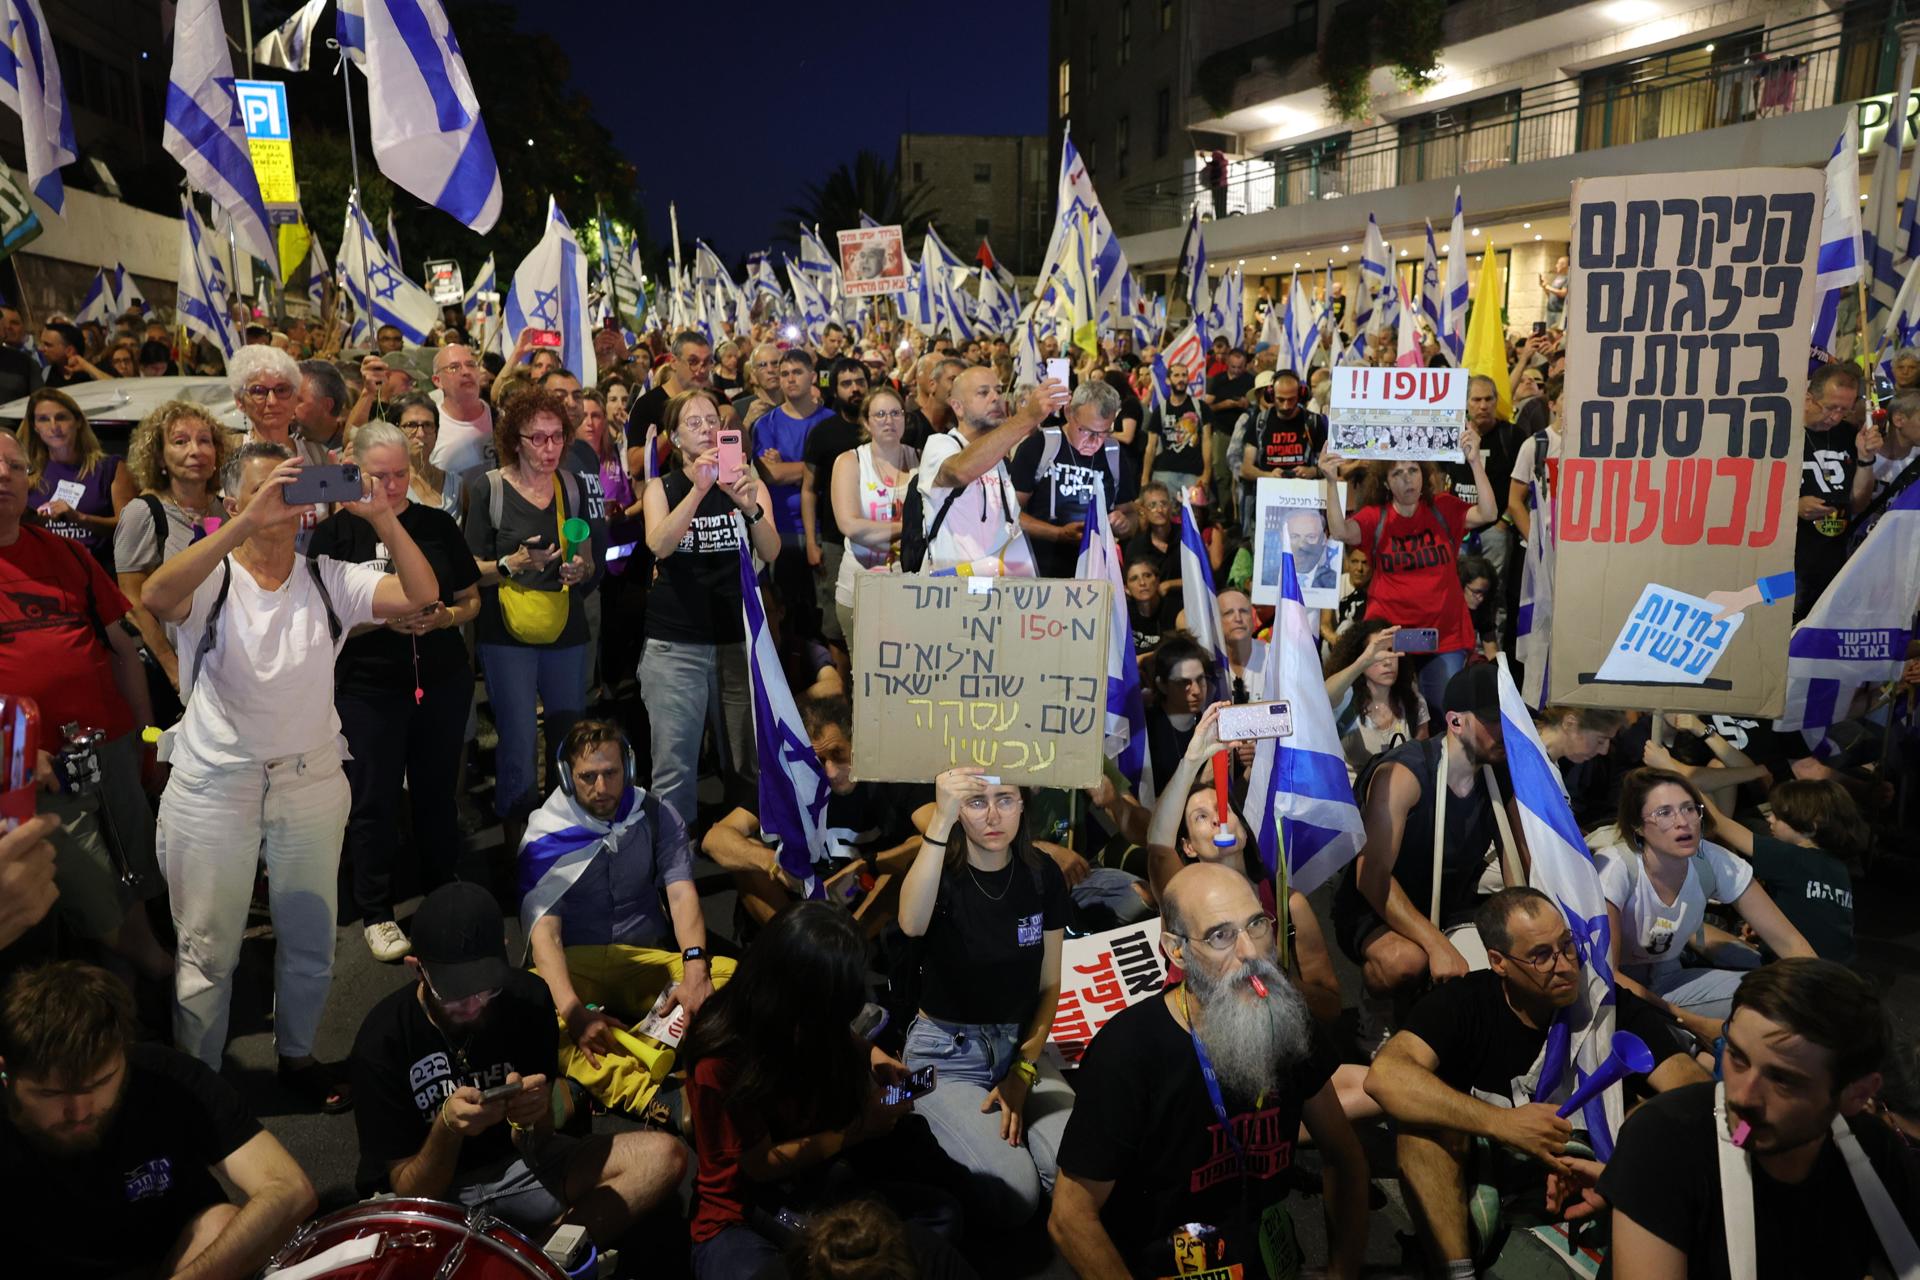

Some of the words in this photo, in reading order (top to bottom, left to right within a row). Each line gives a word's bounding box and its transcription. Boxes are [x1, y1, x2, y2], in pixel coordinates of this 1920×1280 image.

[247, 100, 268, 133] P
[1579, 192, 1815, 269] הפקרתם
[1586, 265, 1803, 333] פילגתם
[1597, 332, 1788, 397] בזזתם
[1383, 371, 1450, 404] עופו
[1580, 396, 1791, 458] הרסתם
[1559, 457, 1786, 548] נכשלתם
[698, 528, 732, 542] כיבוש
[1382, 544, 1450, 573] חטופים
[903, 585, 958, 609] יותר
[973, 585, 1051, 611] עשיתי
[1065, 585, 1099, 609] לא
[962, 615, 1002, 642] ימי
[1635, 593, 1731, 650] בחירות
[1838, 631, 1890, 645] חופשי
[879, 641, 995, 674] מילואים
[1620, 622, 1714, 676] עכשיו!
[1837, 645, 1890, 658] בארצנו
[864, 672, 947, 697] יישארו
[960, 675, 1025, 698] שהם
[1040, 674, 1098, 703] כדי
[907, 699, 1019, 747] עסקה
[950, 736, 1056, 772] עכשיו
[1110, 930, 1165, 996] אותו
[414, 1077, 464, 1111] BRIN
